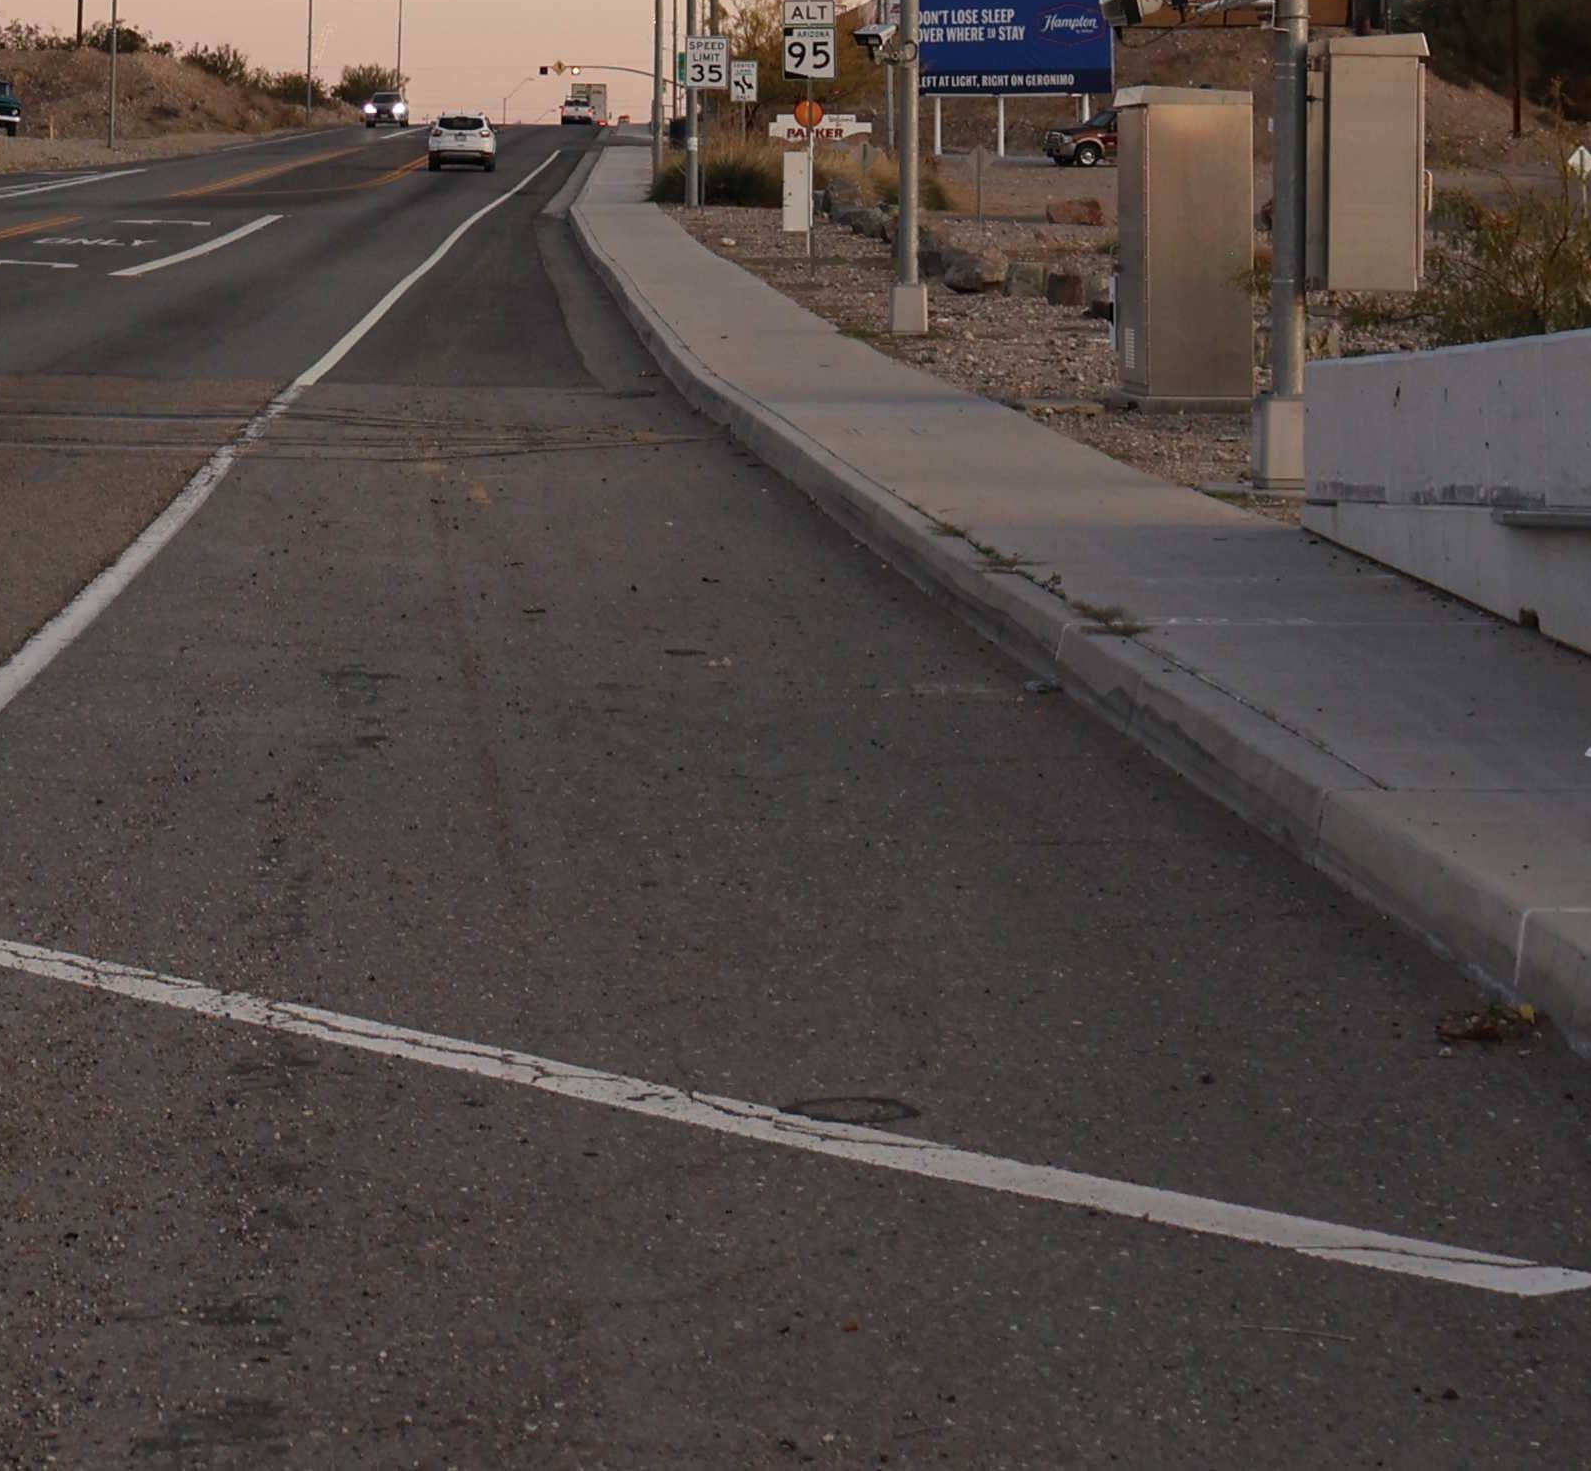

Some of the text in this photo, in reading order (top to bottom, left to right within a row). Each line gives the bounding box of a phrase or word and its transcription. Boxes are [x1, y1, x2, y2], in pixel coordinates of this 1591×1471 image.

[790, 5, 827, 20] ALT
[951, 9, 979, 25] LOSE
[981, 8, 1015, 24] SLEEP
[1040, 13, 1099, 32] Hampton
[946, 27, 985, 42] WHERE
[998, 26, 1026, 41] STAY
[689, 41, 724, 50] SPEED
[692, 53, 720, 62] LIMIT
[787, 41, 830, 69] 95
[690, 64, 723, 83] 35
[938, 75, 951, 87] AT
[982, 74, 1009, 87] RIGHT
[1011, 74, 1024, 86] ON
[1025, 73, 1075, 86] GERONIMO
[786, 128, 844, 139] PAKER
[33, 236, 157, 247] ONLY
